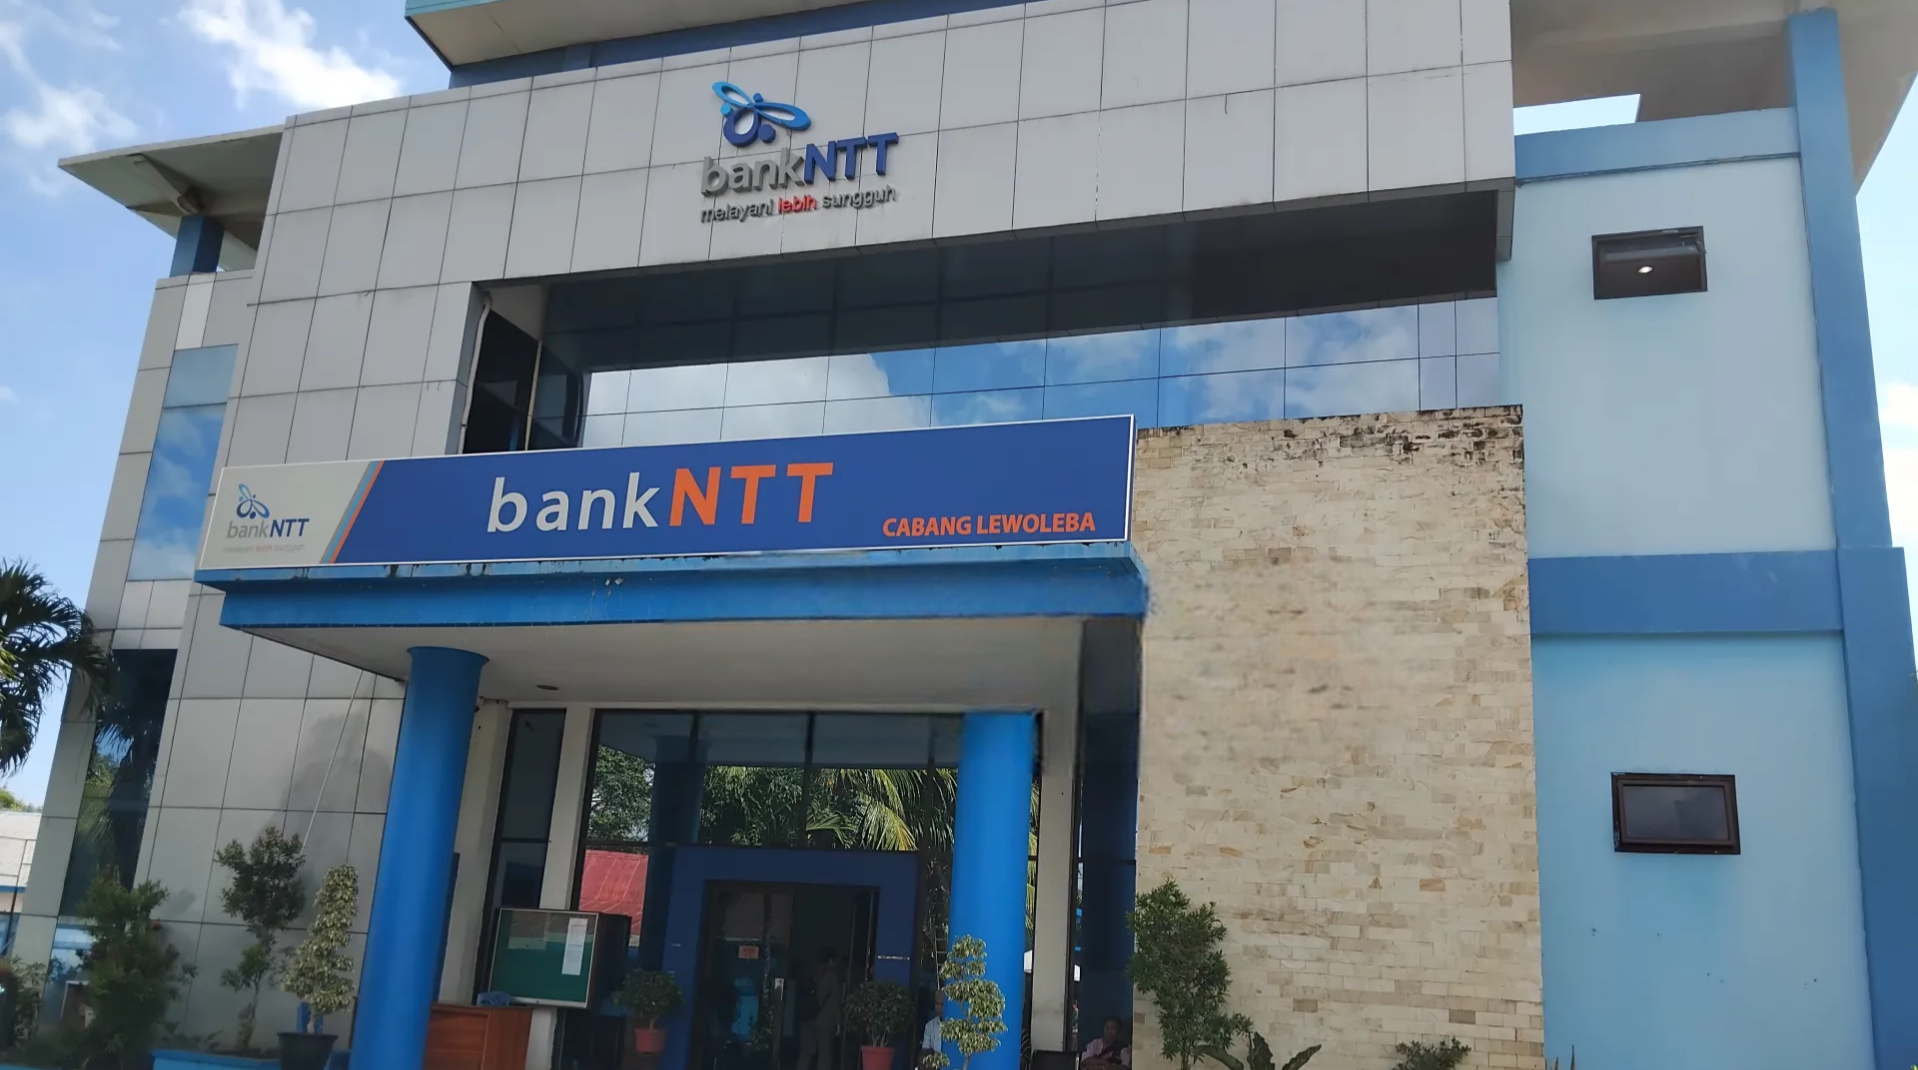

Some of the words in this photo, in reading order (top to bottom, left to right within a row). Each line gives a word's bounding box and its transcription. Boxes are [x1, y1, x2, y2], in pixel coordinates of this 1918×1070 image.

[702, 132, 899, 196] bankNTT
[701, 199, 773, 223] melayani
[777, 194, 817, 214] lebih
[822, 185, 897, 209] sungguh
[487, 462, 834, 533] bankNTT
[226, 518, 310, 539] bankNTT
[883, 515, 971, 537] CABANG
[976, 512, 1096, 535] LEWOLEBA
